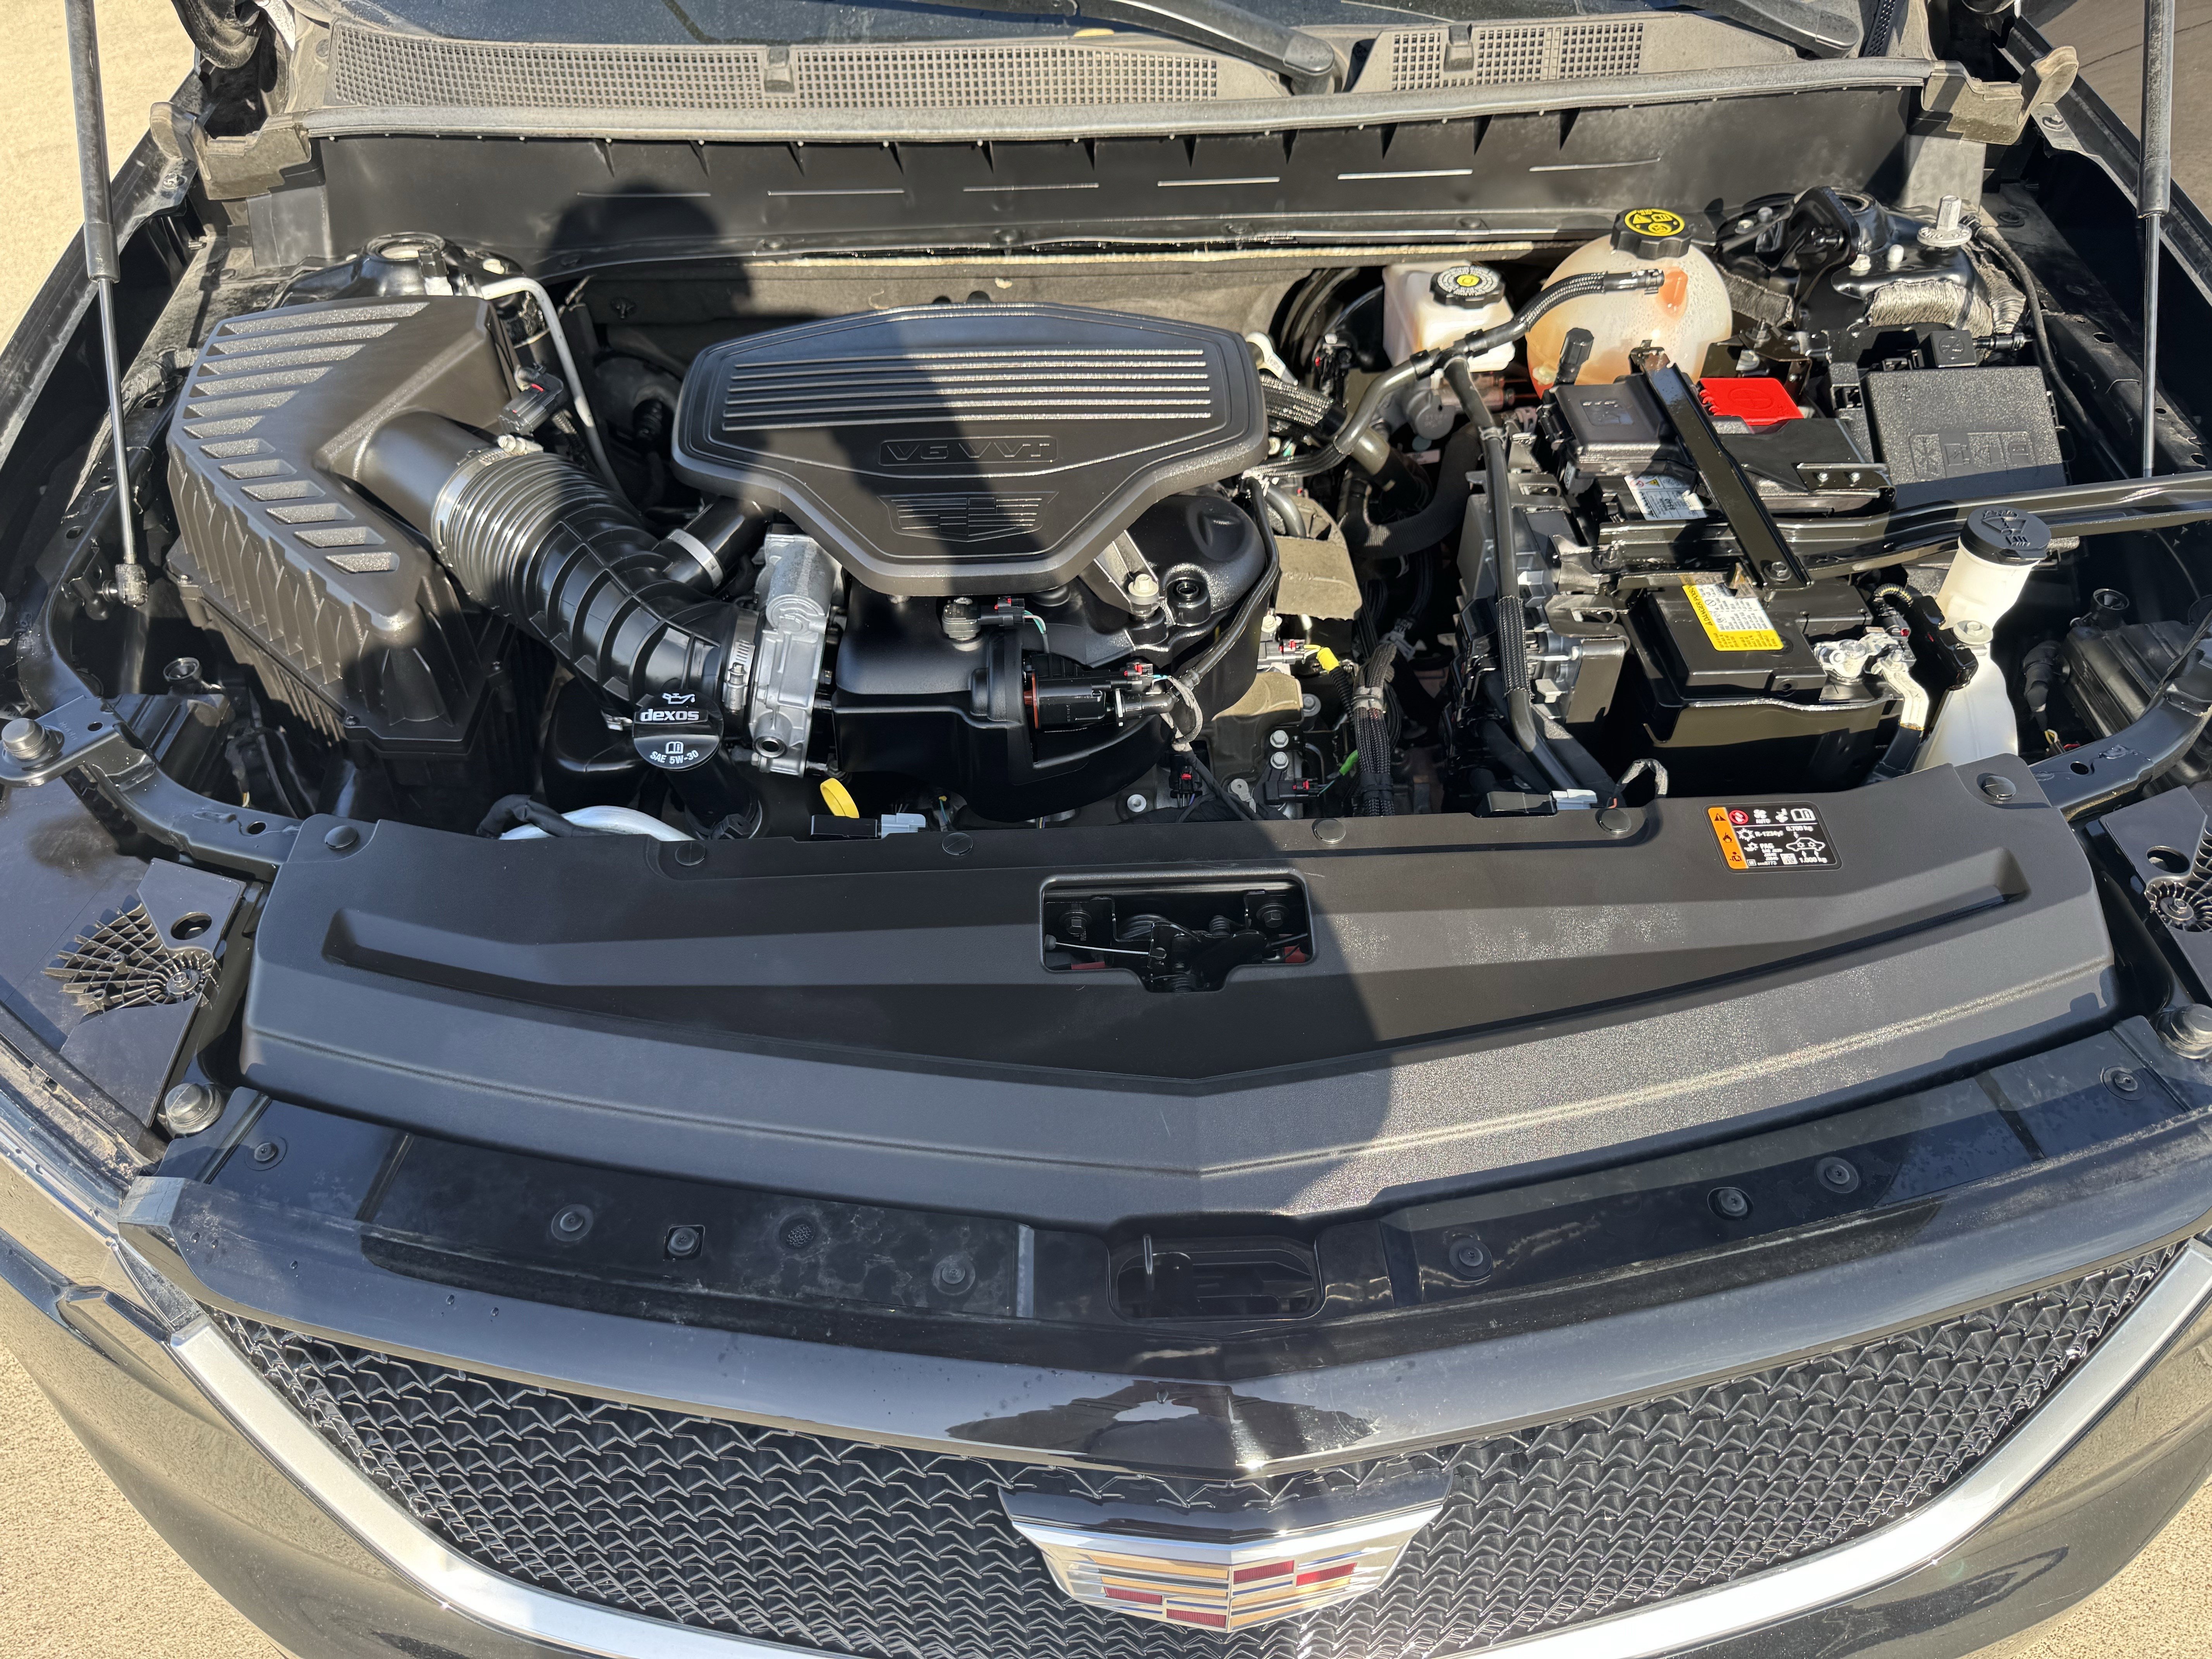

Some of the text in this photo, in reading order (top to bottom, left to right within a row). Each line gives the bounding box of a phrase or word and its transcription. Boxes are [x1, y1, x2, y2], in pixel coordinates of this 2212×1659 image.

[887, 442, 1050, 460] V6 VVT
[640, 709, 699, 721] dexos
[650, 750, 699, 764] SAE 5W-30
